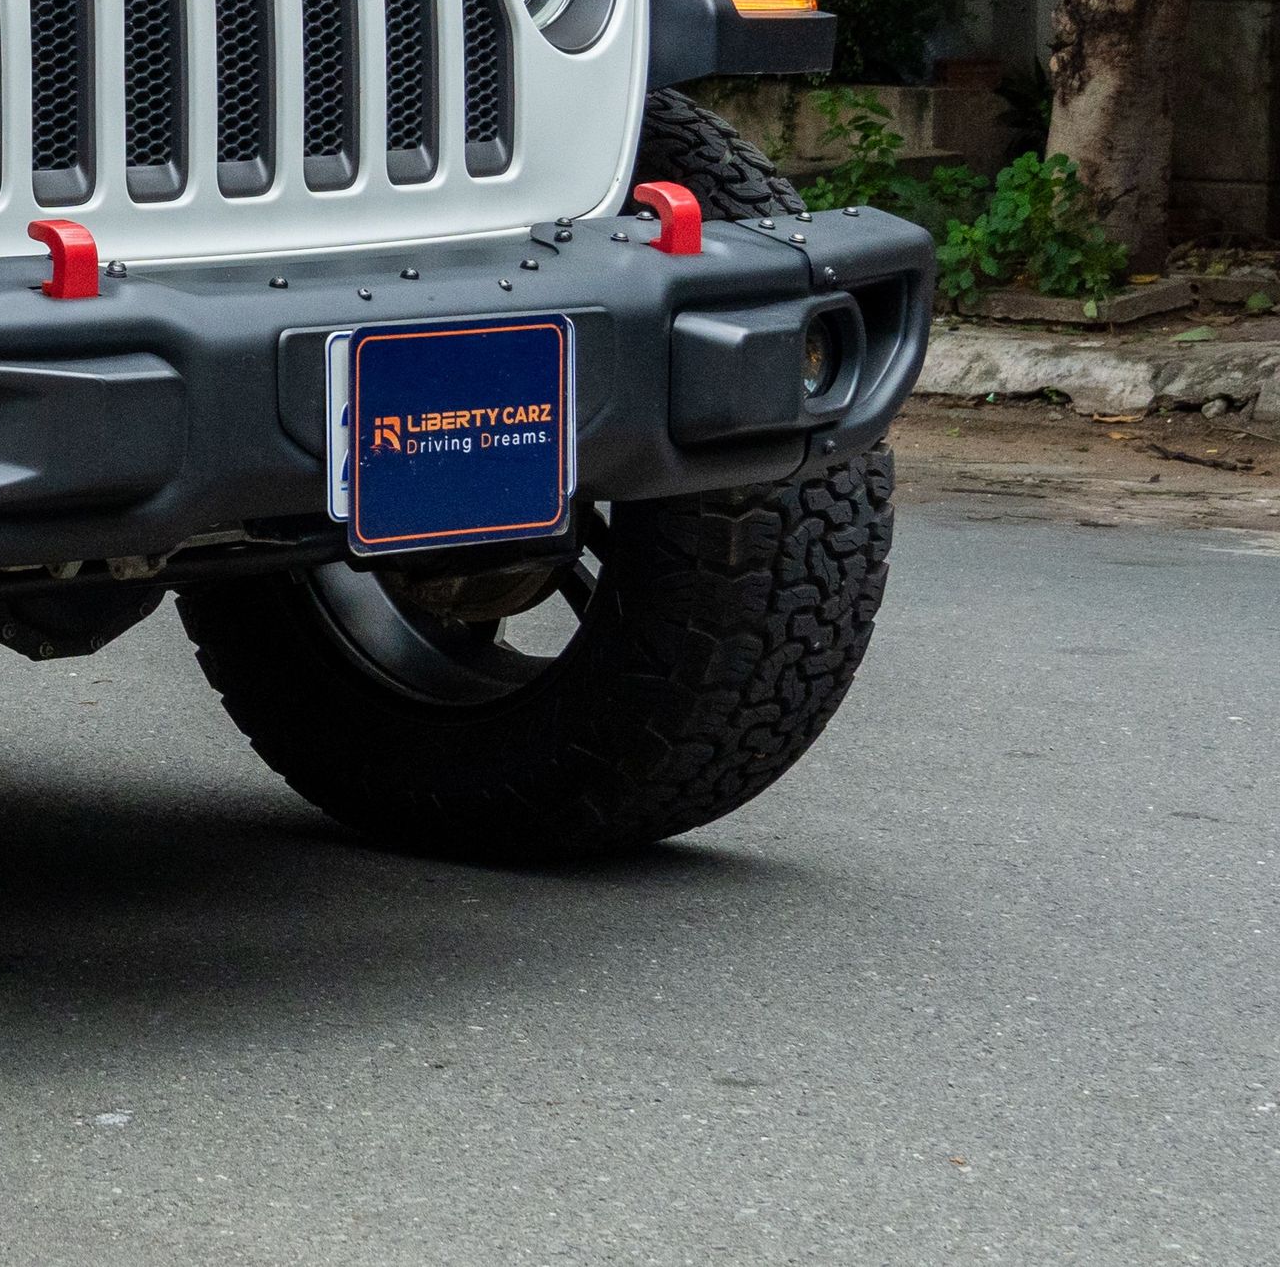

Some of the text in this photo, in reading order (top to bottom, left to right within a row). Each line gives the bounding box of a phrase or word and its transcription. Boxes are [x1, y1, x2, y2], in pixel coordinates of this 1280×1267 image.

[502, 403, 552, 425] CARZ
[407, 429, 552, 454] Driving Dreams.
